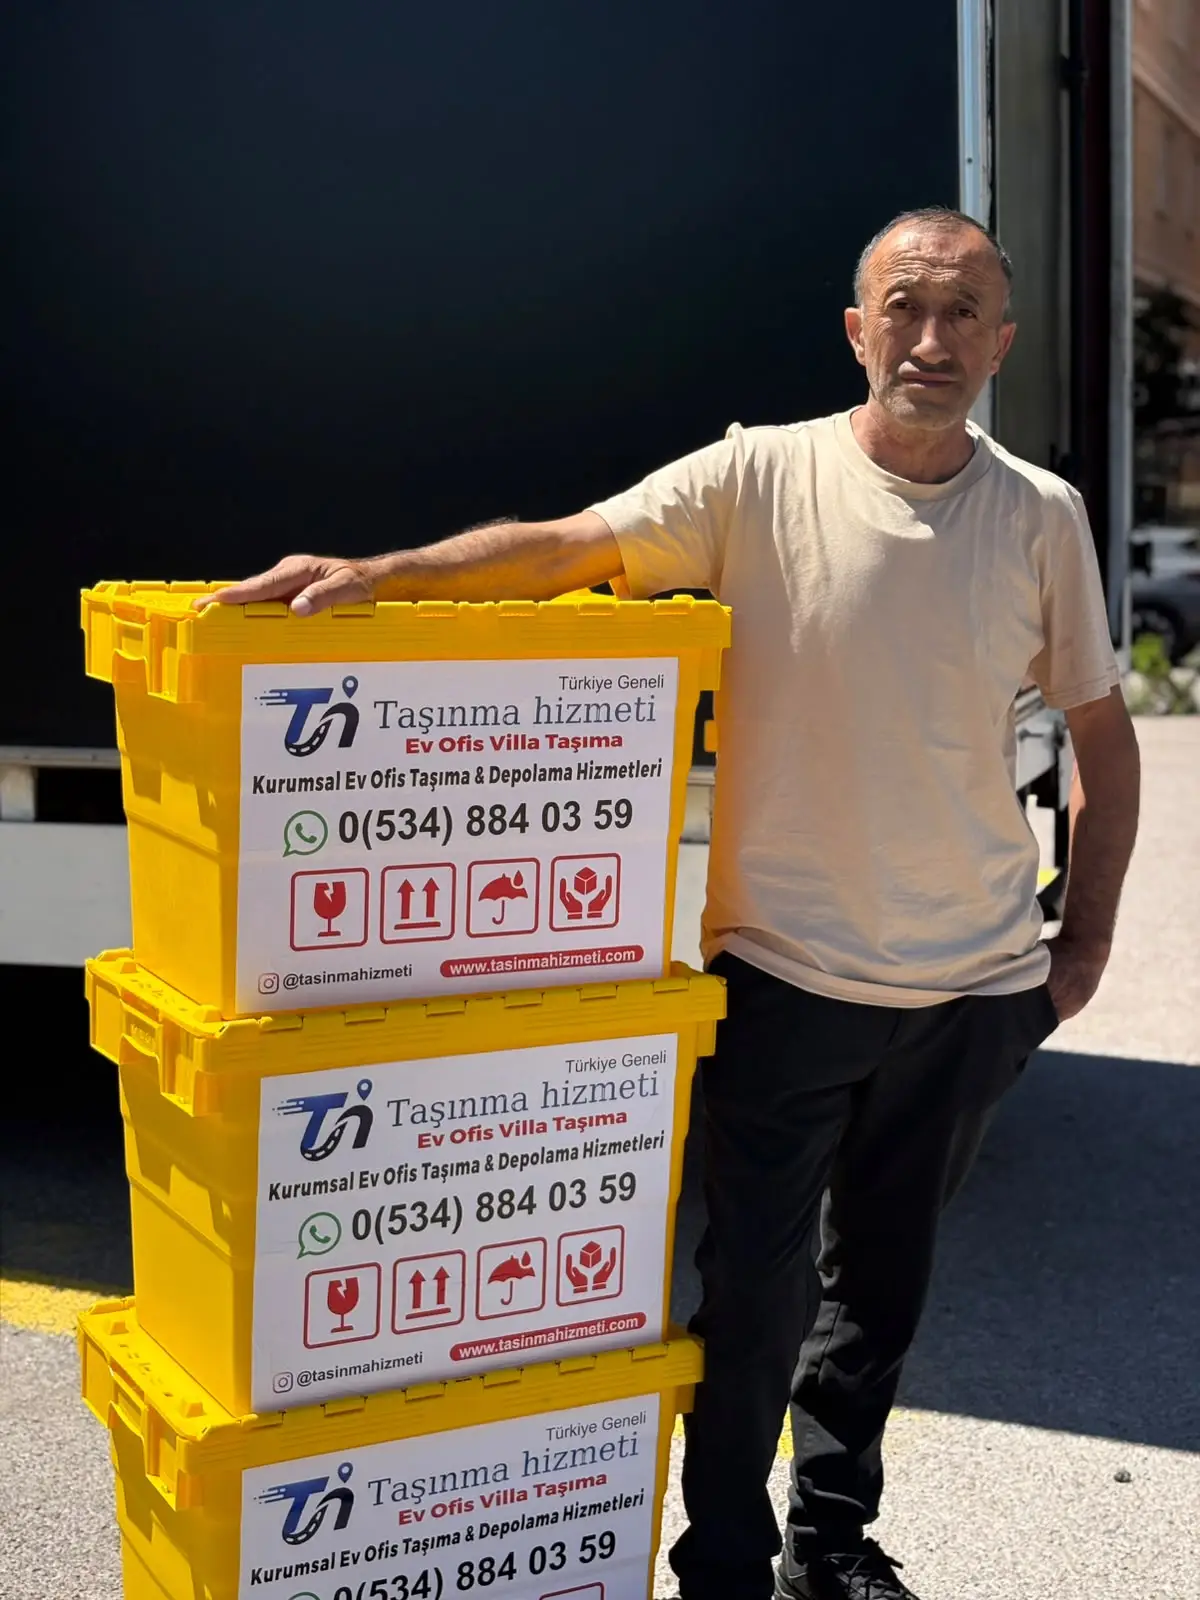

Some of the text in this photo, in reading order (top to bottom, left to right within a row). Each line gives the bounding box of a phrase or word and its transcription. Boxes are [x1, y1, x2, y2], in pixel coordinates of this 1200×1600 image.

[559, 674, 665, 693] Türkiye Geneli
[374, 694, 657, 735] Taşınma hizmeti
[406, 734, 623, 755] Ev Ofis Villa Taşıma
[252, 758, 662, 795] Kurumsal Ev Ofis Taşıma & Depolama Hizmetleri
[338, 798, 633, 850] 0(534) 884 03 59
[283, 964, 413, 990] @tasinmahizmeti
[449, 948, 636, 976] www.tasinmahizmeti.com
[565, 1050, 667, 1076] Türkiye Geneli
[387, 1070, 659, 1129] Taşınma hizmeti
[417, 1112, 628, 1149] Ev Ofis Villa Taşıma
[268, 1130, 664, 1202] Kurumsal Ev Ofis Taşıma & Depolama Hizmetleri
[351, 1171, 637, 1246] 0(534) 884 03 59
[459, 1315, 639, 1359] www.tasinmahizmeti.com
[296, 1351, 424, 1387] @tasinmahizmeti
[546, 1411, 647, 1443] Türkiye Geneli
[367, 1431, 639, 1507] Taşınma hizmeti
[398, 1471, 608, 1526] Ev Ofis Villa Taşıma
[250, 1488, 645, 1586] Kurumsal Ev Ofis Taşıma & Depolama Hizmetleri
[456, 1552, 517, 1592] 884
[528, 1541, 567, 1575] 03
[579, 1530, 617, 1564] 59
